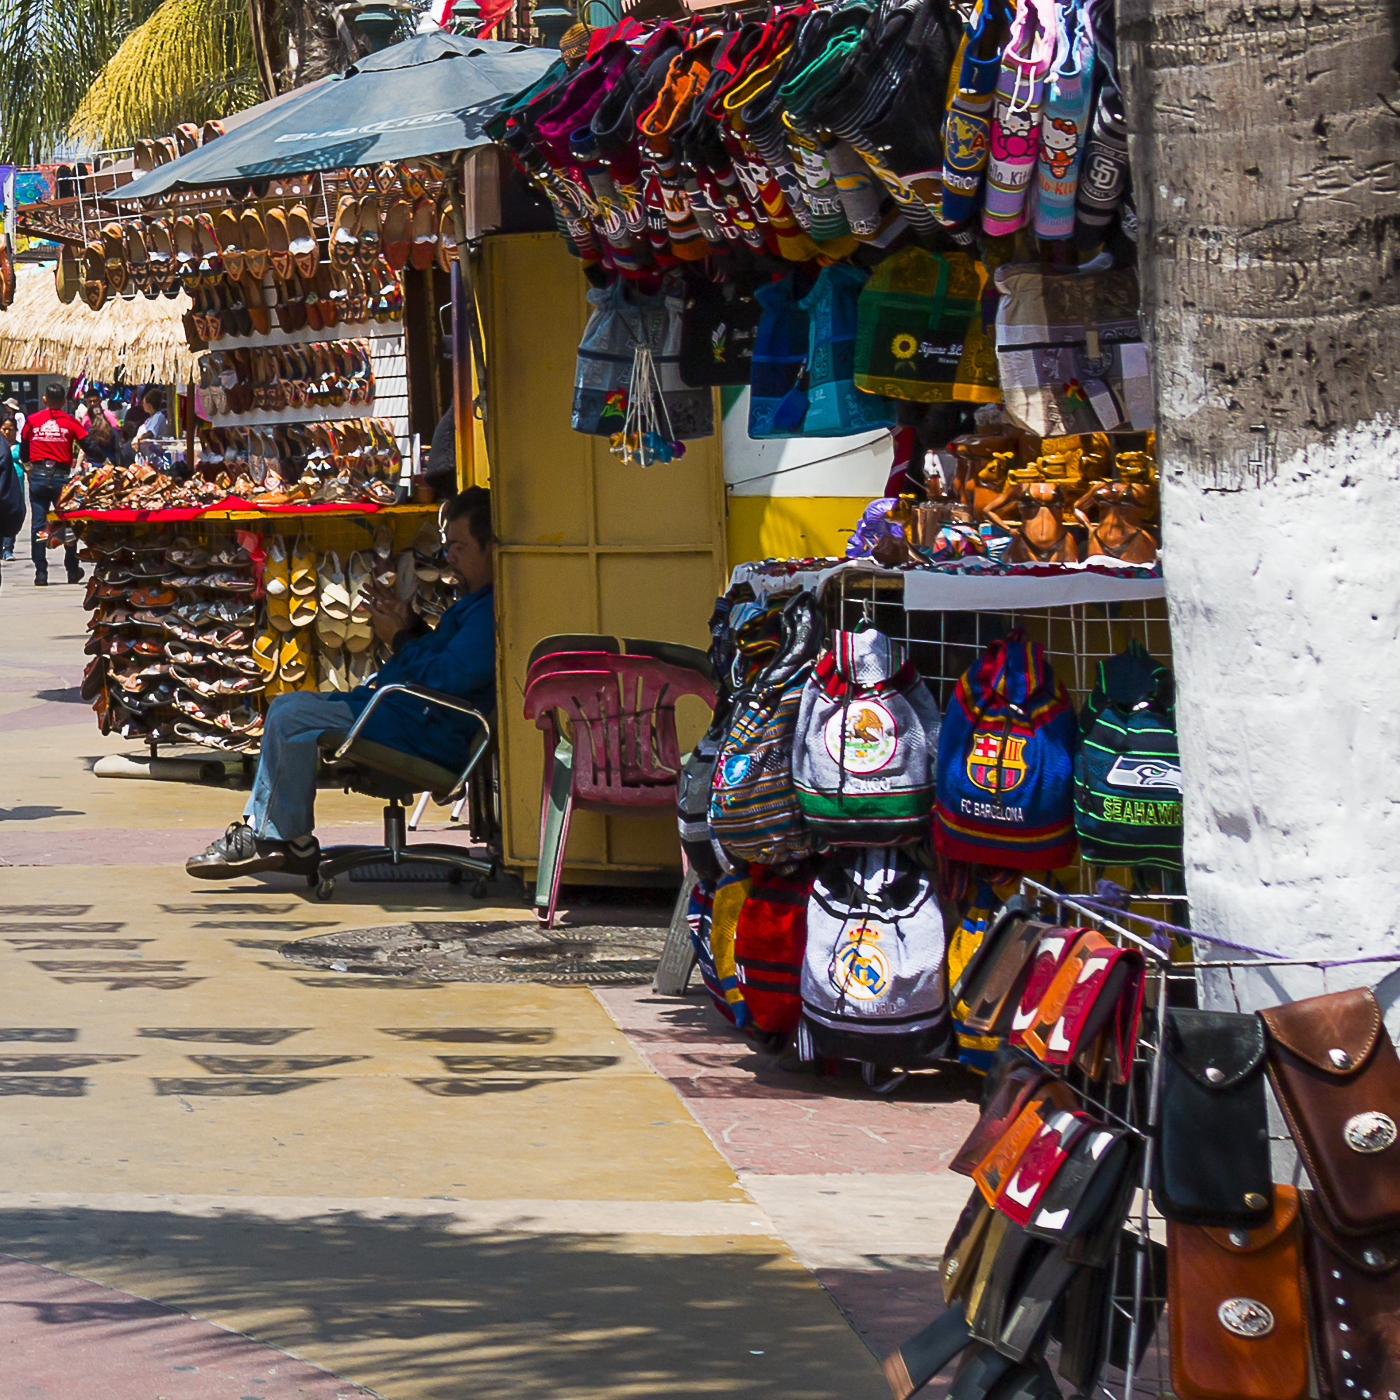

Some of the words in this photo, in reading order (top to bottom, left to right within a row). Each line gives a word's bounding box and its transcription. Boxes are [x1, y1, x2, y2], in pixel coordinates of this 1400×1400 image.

[961, 798, 972, 813] FC
[974, 803, 1025, 822] BARCELONA
[1103, 797, 1183, 825] SEAHAWK
